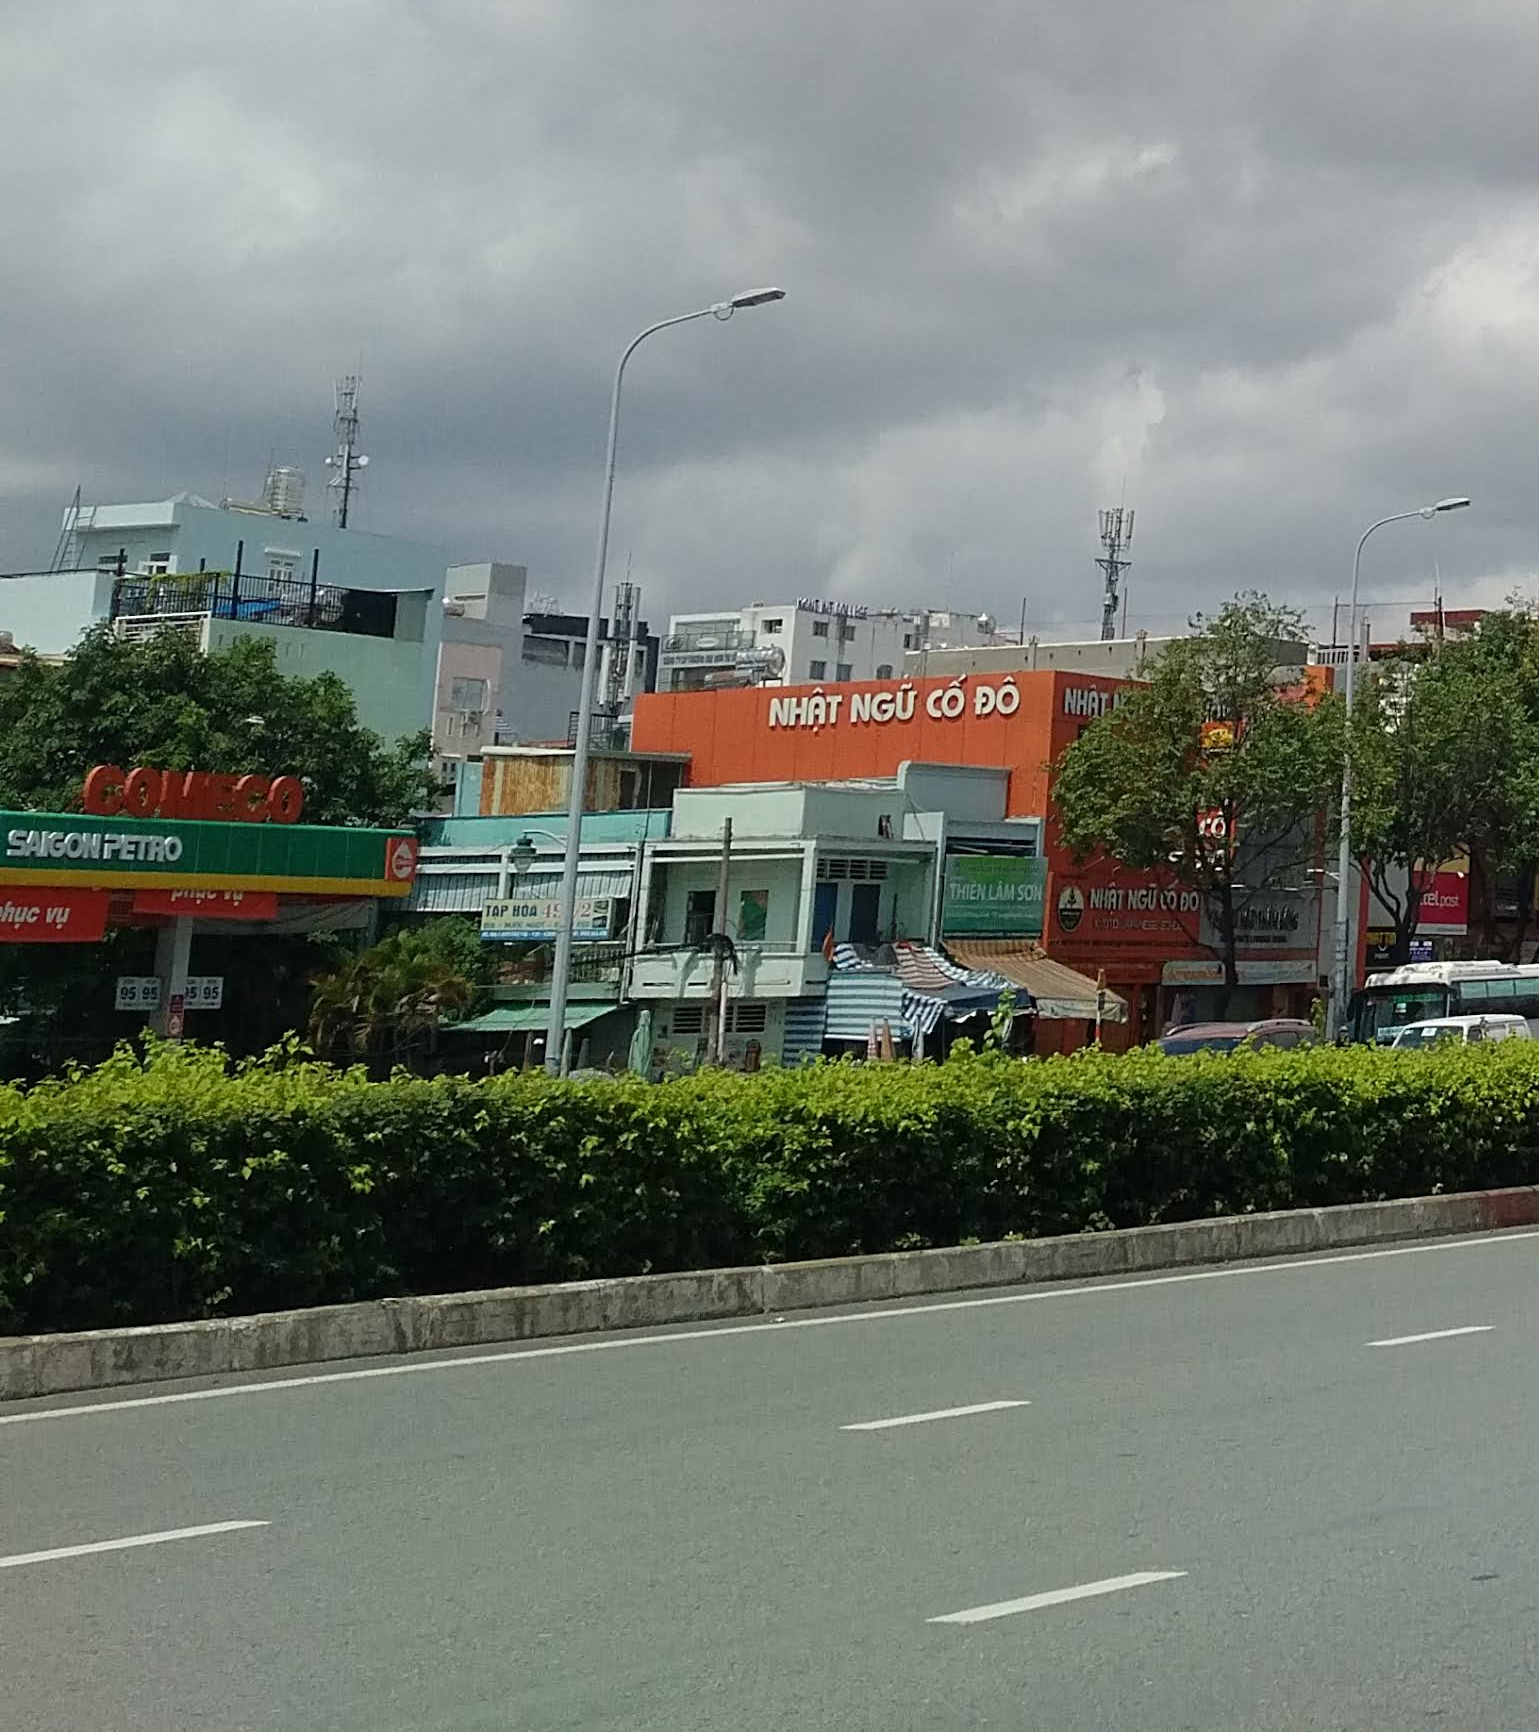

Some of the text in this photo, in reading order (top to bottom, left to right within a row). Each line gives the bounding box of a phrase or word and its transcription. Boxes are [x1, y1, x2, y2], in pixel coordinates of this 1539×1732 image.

[769, 674, 1021, 732] NHẬT NGỮ CỐ ĐÔ
[83, 765, 303, 823] COMECO
[0, 901, 71, 929] hục vụ
[1090, 882, 1124, 915] NHẬT
